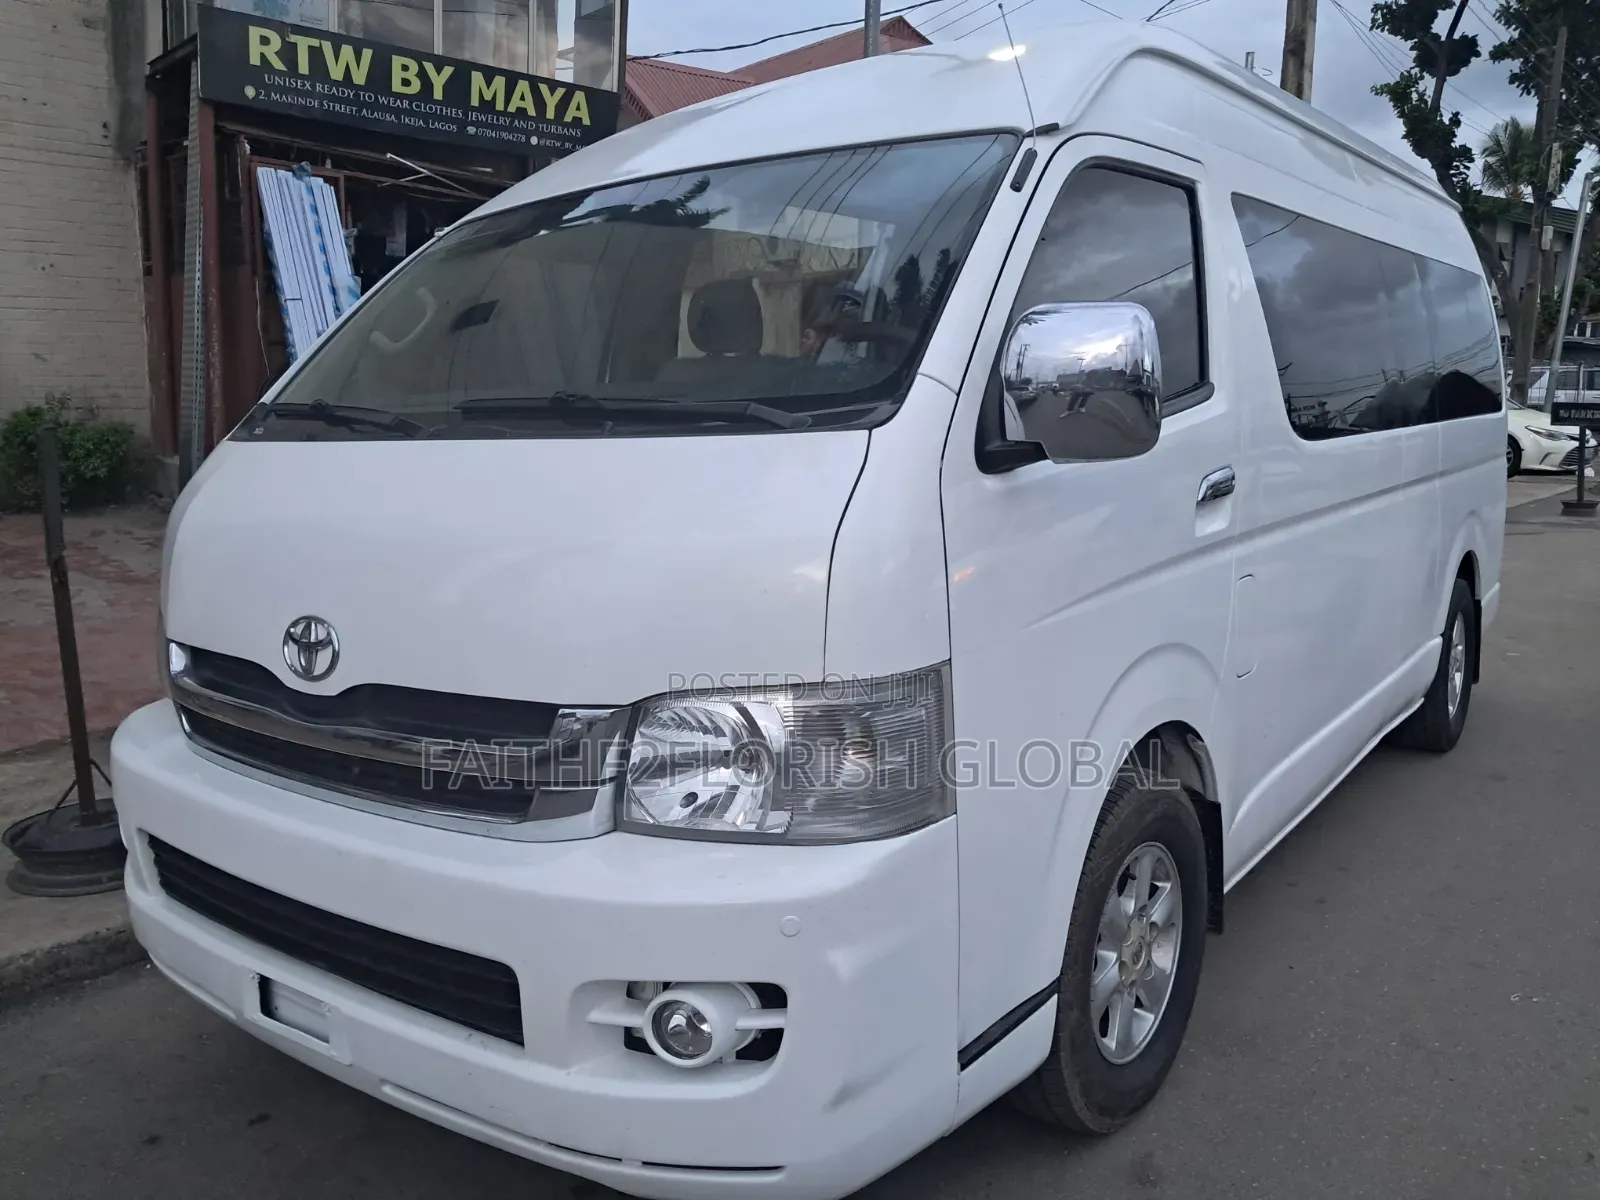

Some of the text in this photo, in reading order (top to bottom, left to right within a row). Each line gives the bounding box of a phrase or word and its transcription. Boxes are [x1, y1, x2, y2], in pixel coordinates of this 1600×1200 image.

[248, 25, 591, 126] RTW BY MAYA
[264, 74, 312, 91] UNISEX
[315, 82, 356, 99] READY
[358, 90, 375, 103] TO
[378, 94, 410, 109] WEAR
[467, 111, 511, 126] JEWELRY
[513, 119, 536, 131] AND
[538, 123, 581, 138] TURBANS
[270, 91, 320, 108] MAKINDE
[429, 119, 458, 133] LAGOS
[477, 127, 526, 143] 07041904278
